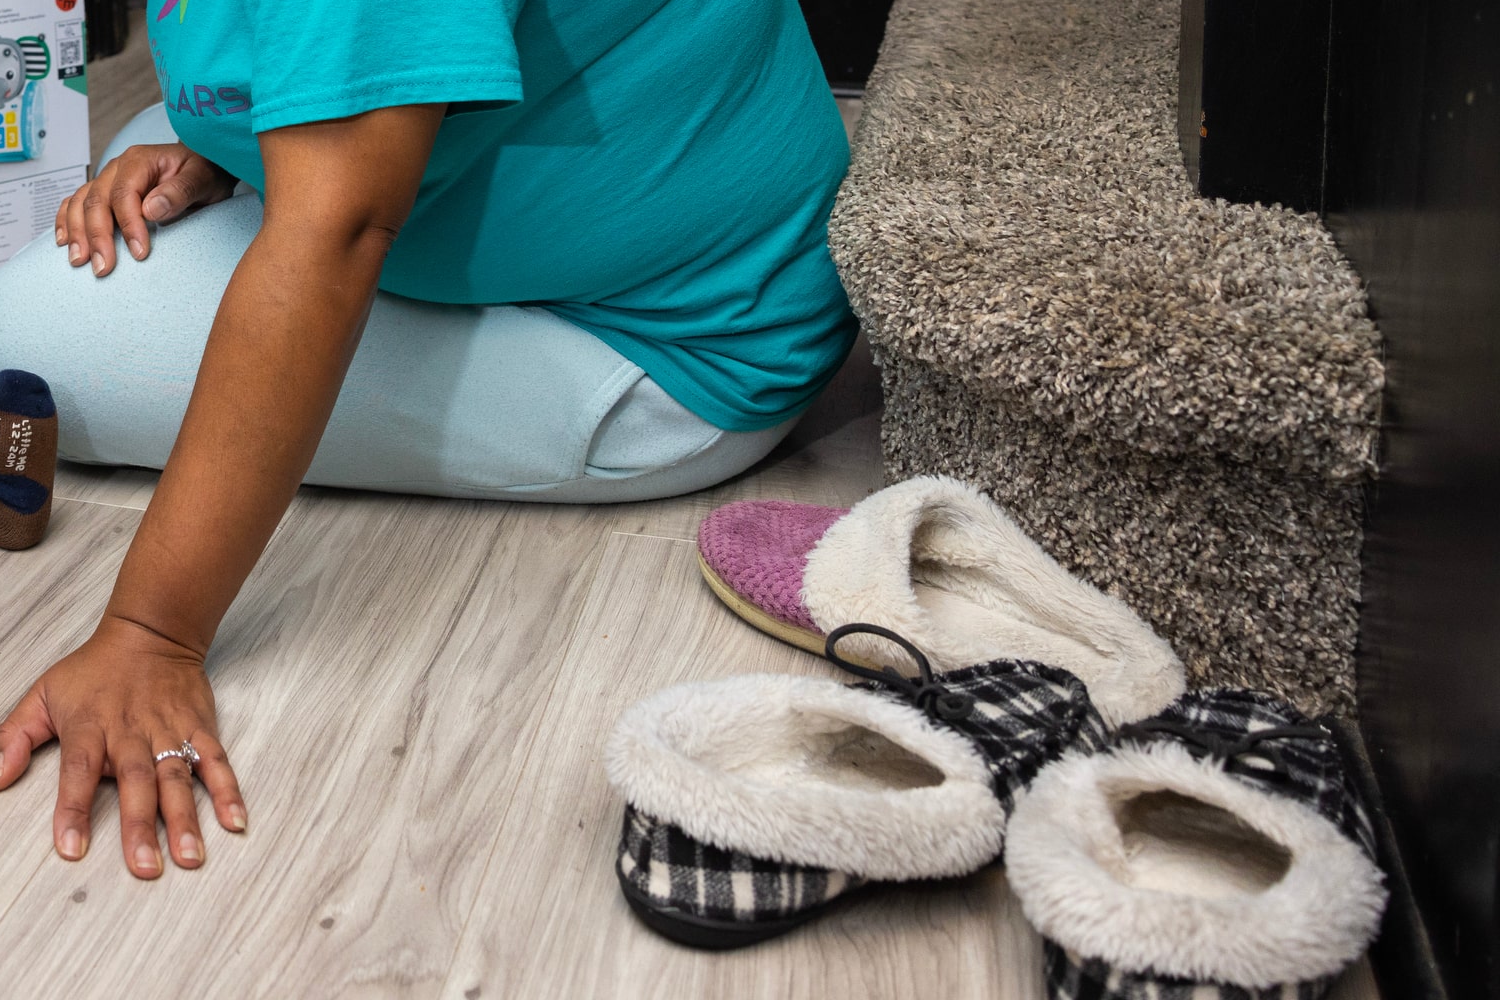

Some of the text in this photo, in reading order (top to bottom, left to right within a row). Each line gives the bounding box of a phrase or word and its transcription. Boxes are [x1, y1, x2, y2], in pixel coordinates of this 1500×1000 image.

[8, 132, 15, 143] 3
[5, 422, 21, 467] 12-24M
[15, 456, 27, 471] Me
